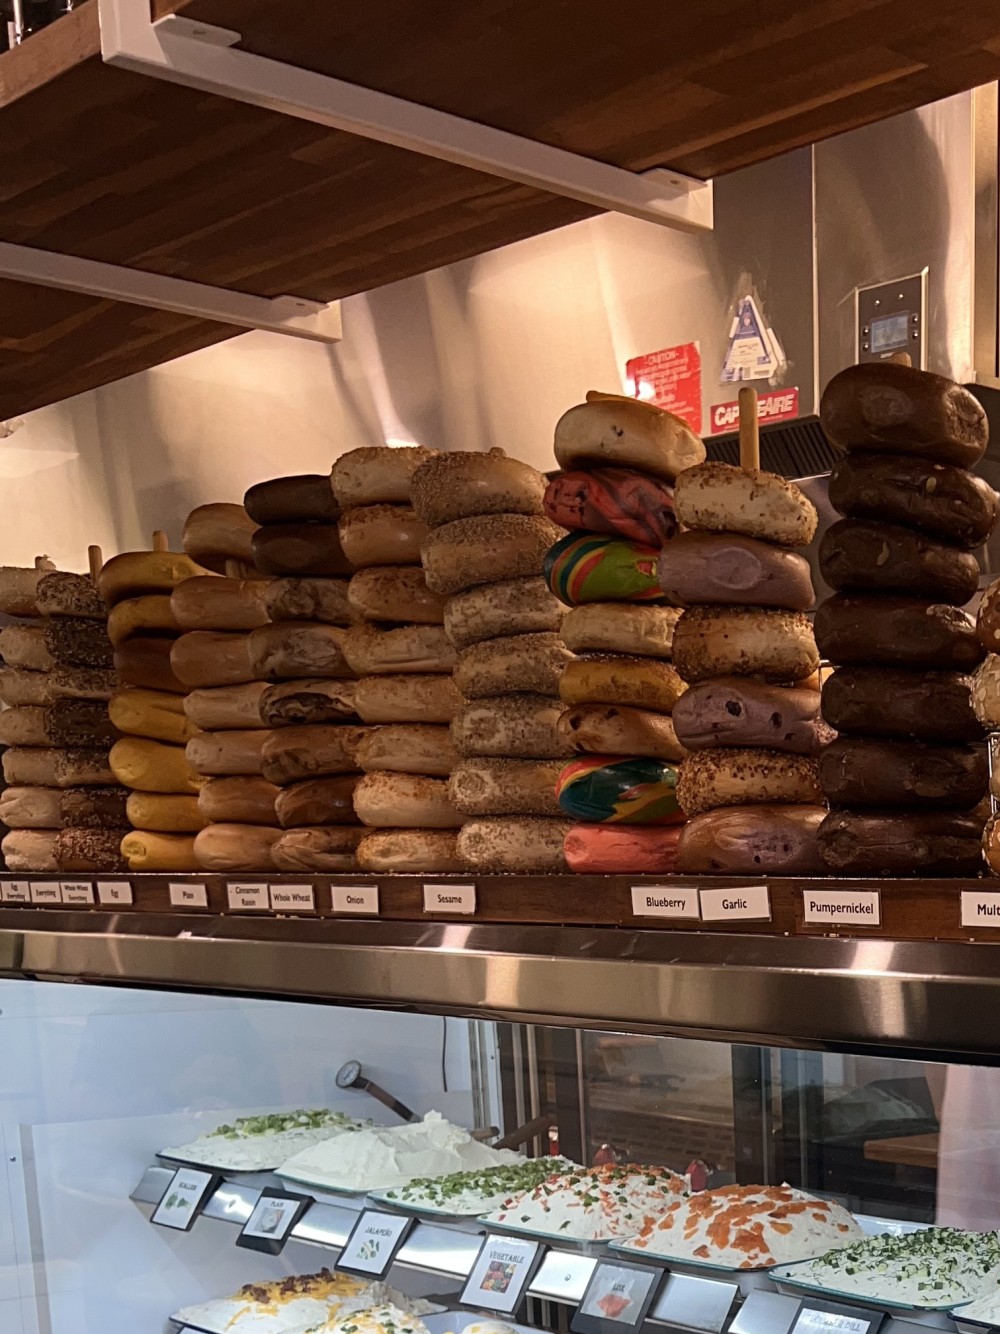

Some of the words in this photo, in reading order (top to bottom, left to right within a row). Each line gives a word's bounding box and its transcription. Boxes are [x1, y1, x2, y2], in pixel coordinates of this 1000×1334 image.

[273, 893, 291, 902] Whole
[291, 893, 311, 902] Wheat
[346, 895, 364, 905] Onion
[437, 893, 462, 904] Sesame
[645, 896, 686, 911] Blueberry
[722, 898, 747, 910] Garlic
[809, 900, 874, 915] Pumpernickel
[489, 1250, 525, 1264] VEGETABLE
[612, 1282, 626, 1293] LOX
